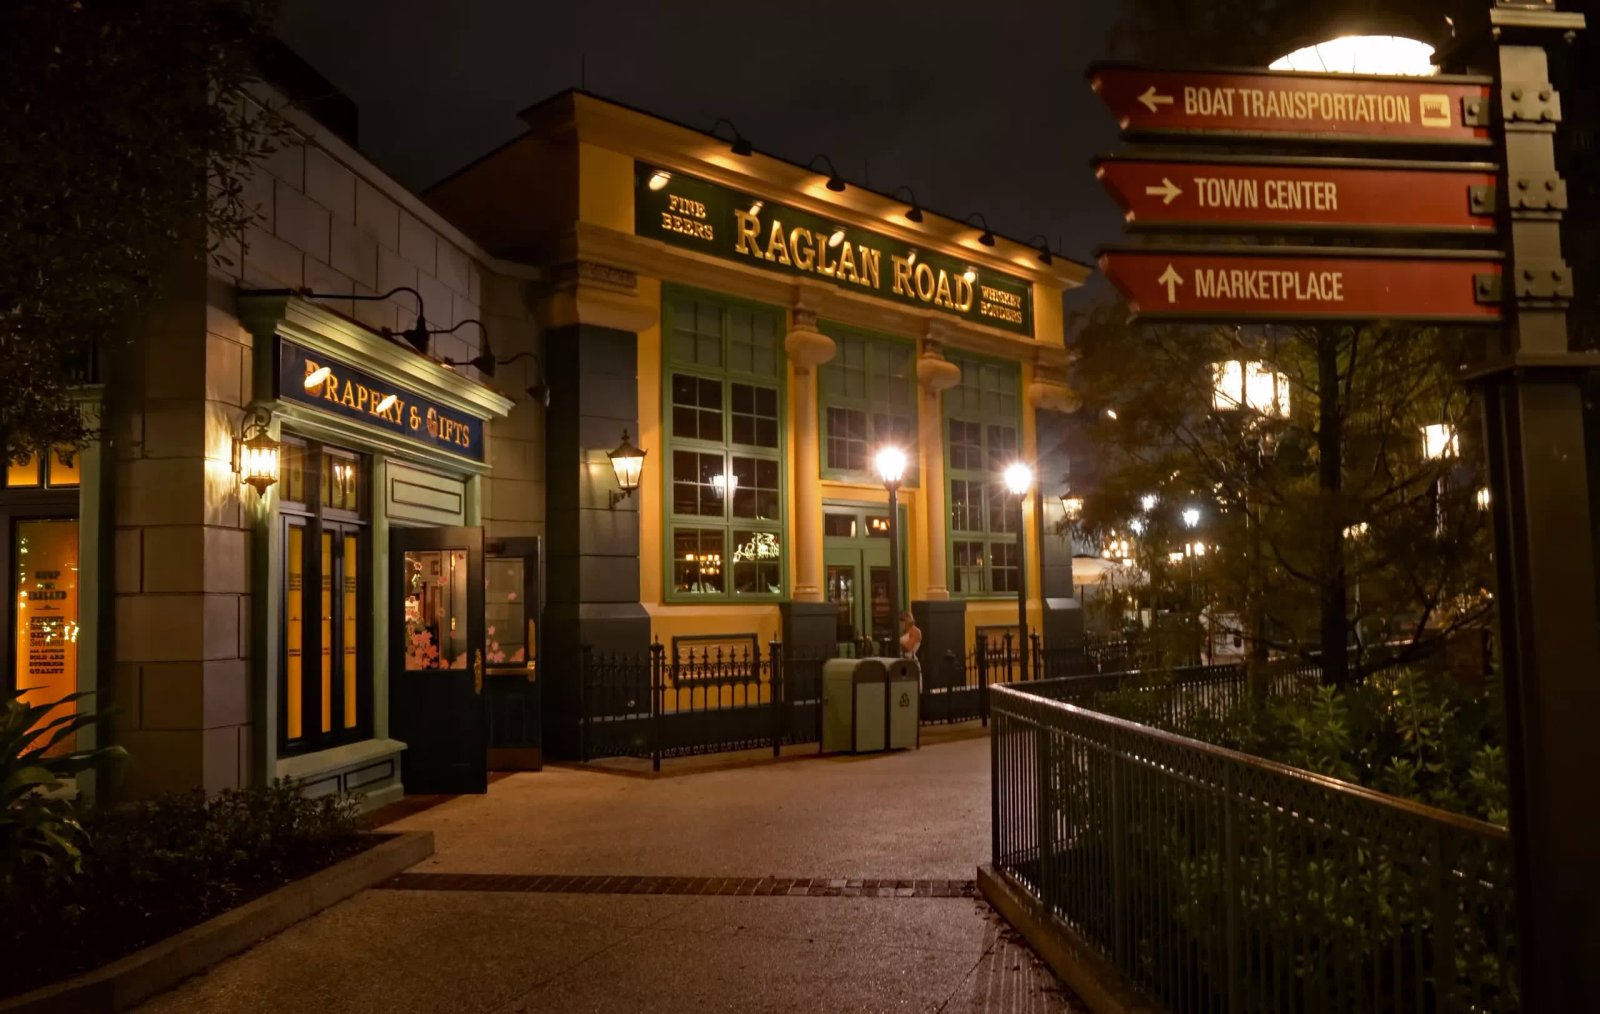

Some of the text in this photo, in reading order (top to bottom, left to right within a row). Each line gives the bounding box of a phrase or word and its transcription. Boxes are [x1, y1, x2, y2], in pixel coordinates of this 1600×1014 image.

[1184, 86, 1412, 123] BOAT TRANSPORTATION
[669, 194, 706, 219] FINE
[1194, 177, 1338, 211] TOWN CENTER
[661, 212, 714, 241] BEERS
[734, 207, 974, 313] RAGLAN ROAD
[1194, 268, 1344, 301] MARKETPLACE
[409, 406, 422, 431] &
[426, 406, 470, 448] GIFTS
